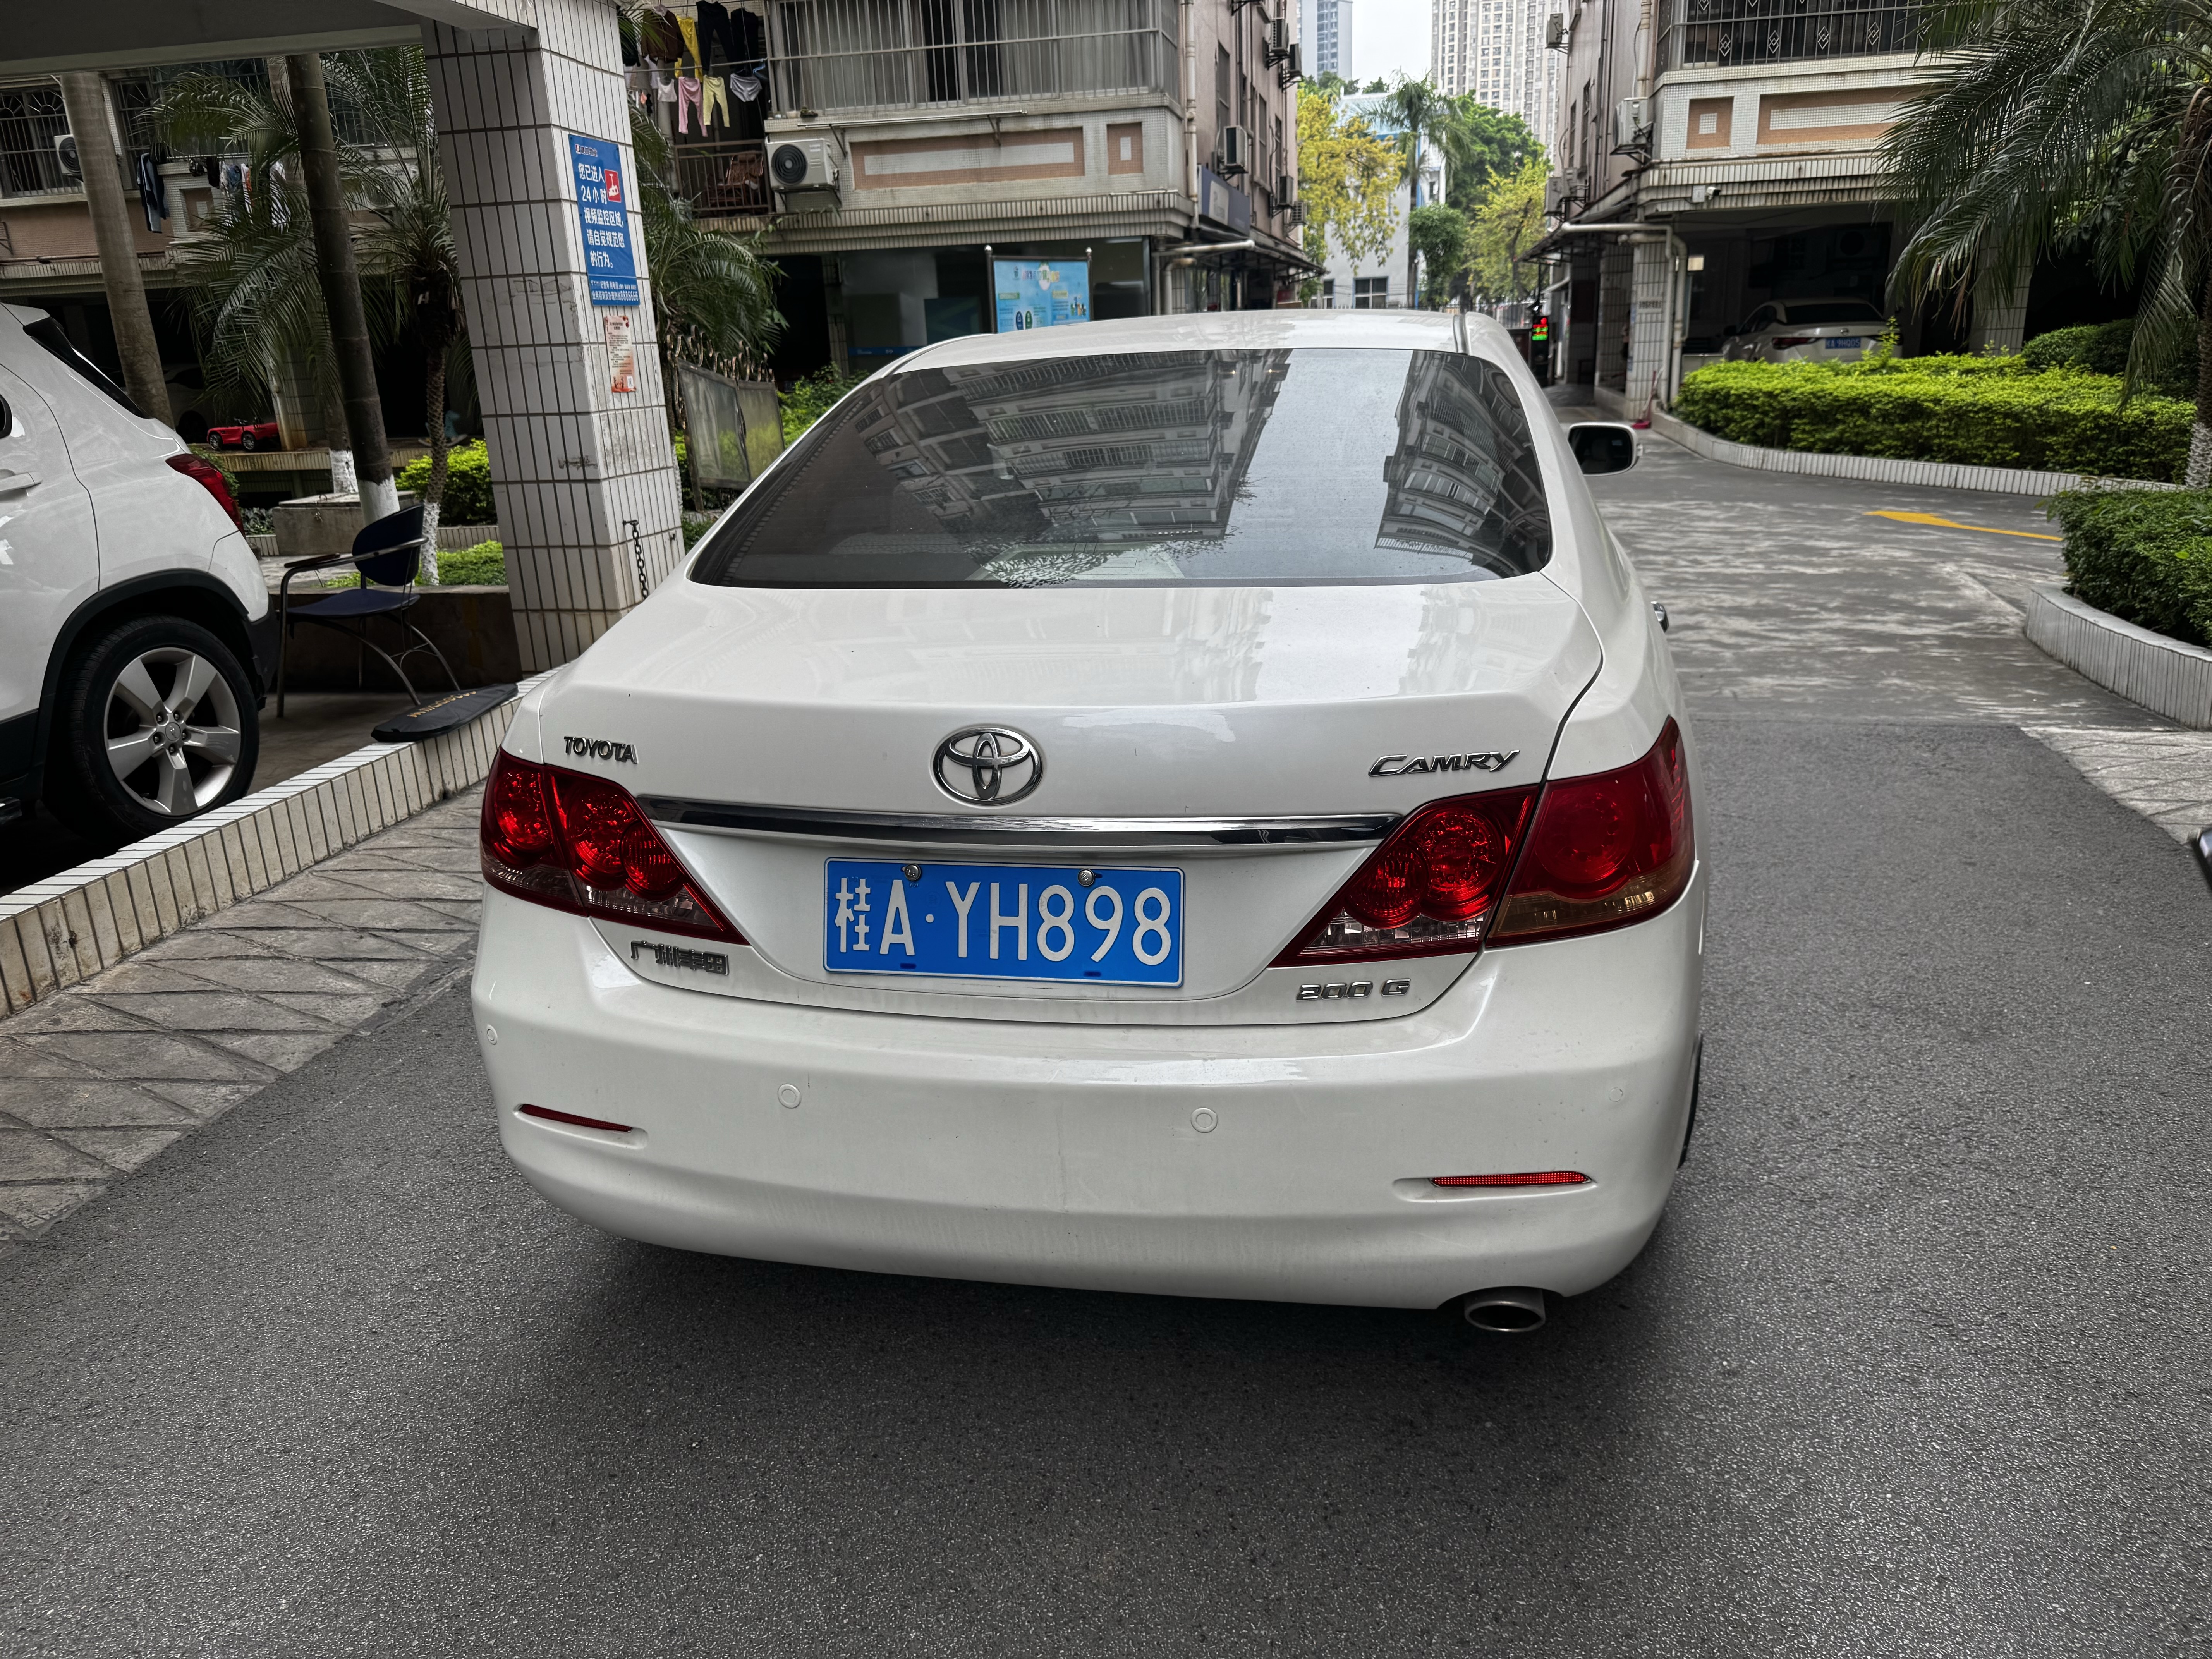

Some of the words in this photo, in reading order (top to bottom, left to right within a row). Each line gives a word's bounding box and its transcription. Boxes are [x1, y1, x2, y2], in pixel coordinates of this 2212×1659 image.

[586, 228, 625, 248] 请自觉规范您
[590, 250, 613, 268] 的行为。
[564, 736, 639, 764] TOYOTA
[1368, 750, 1520, 776] CAMRY
[835, 878, 1171, 965] 桂A·YH898
[1296, 981, 1373, 1001] 200
[1381, 978, 1411, 996] G
